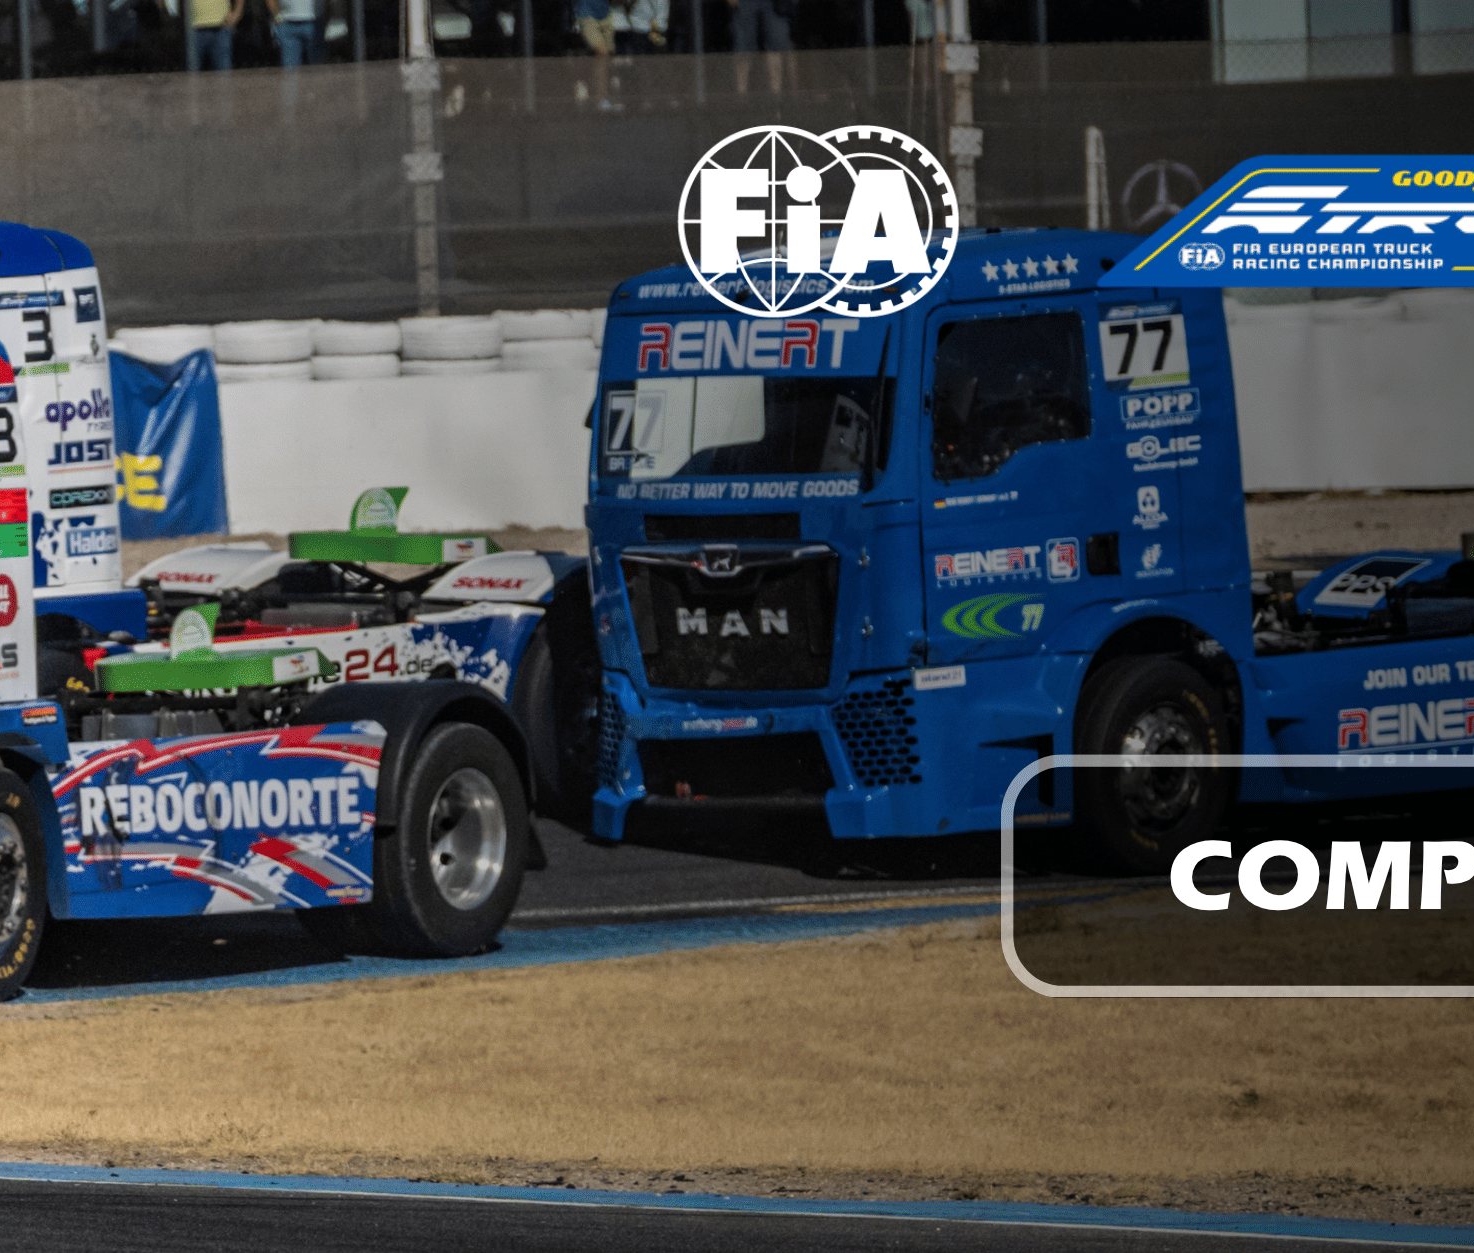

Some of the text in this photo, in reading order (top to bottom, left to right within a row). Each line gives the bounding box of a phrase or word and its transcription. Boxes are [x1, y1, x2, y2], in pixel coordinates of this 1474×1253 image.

[637, 319, 860, 372] REINERT
[1109, 320, 1172, 375] 77
[1126, 393, 1193, 418] POPP
[48, 438, 112, 465] JOST
[616, 479, 859, 499] NO BETTER WAY TO MOVE GOODS
[934, 545, 1041, 577] REINERT
[157, 571, 219, 584] SONAX
[454, 577, 529, 590] SONAX
[676, 606, 789, 637] MAN
[1363, 668, 1407, 690] JOIN
[1411, 663, 1451, 686] OUR
[80, 777, 359, 836] REBOCONORTE
